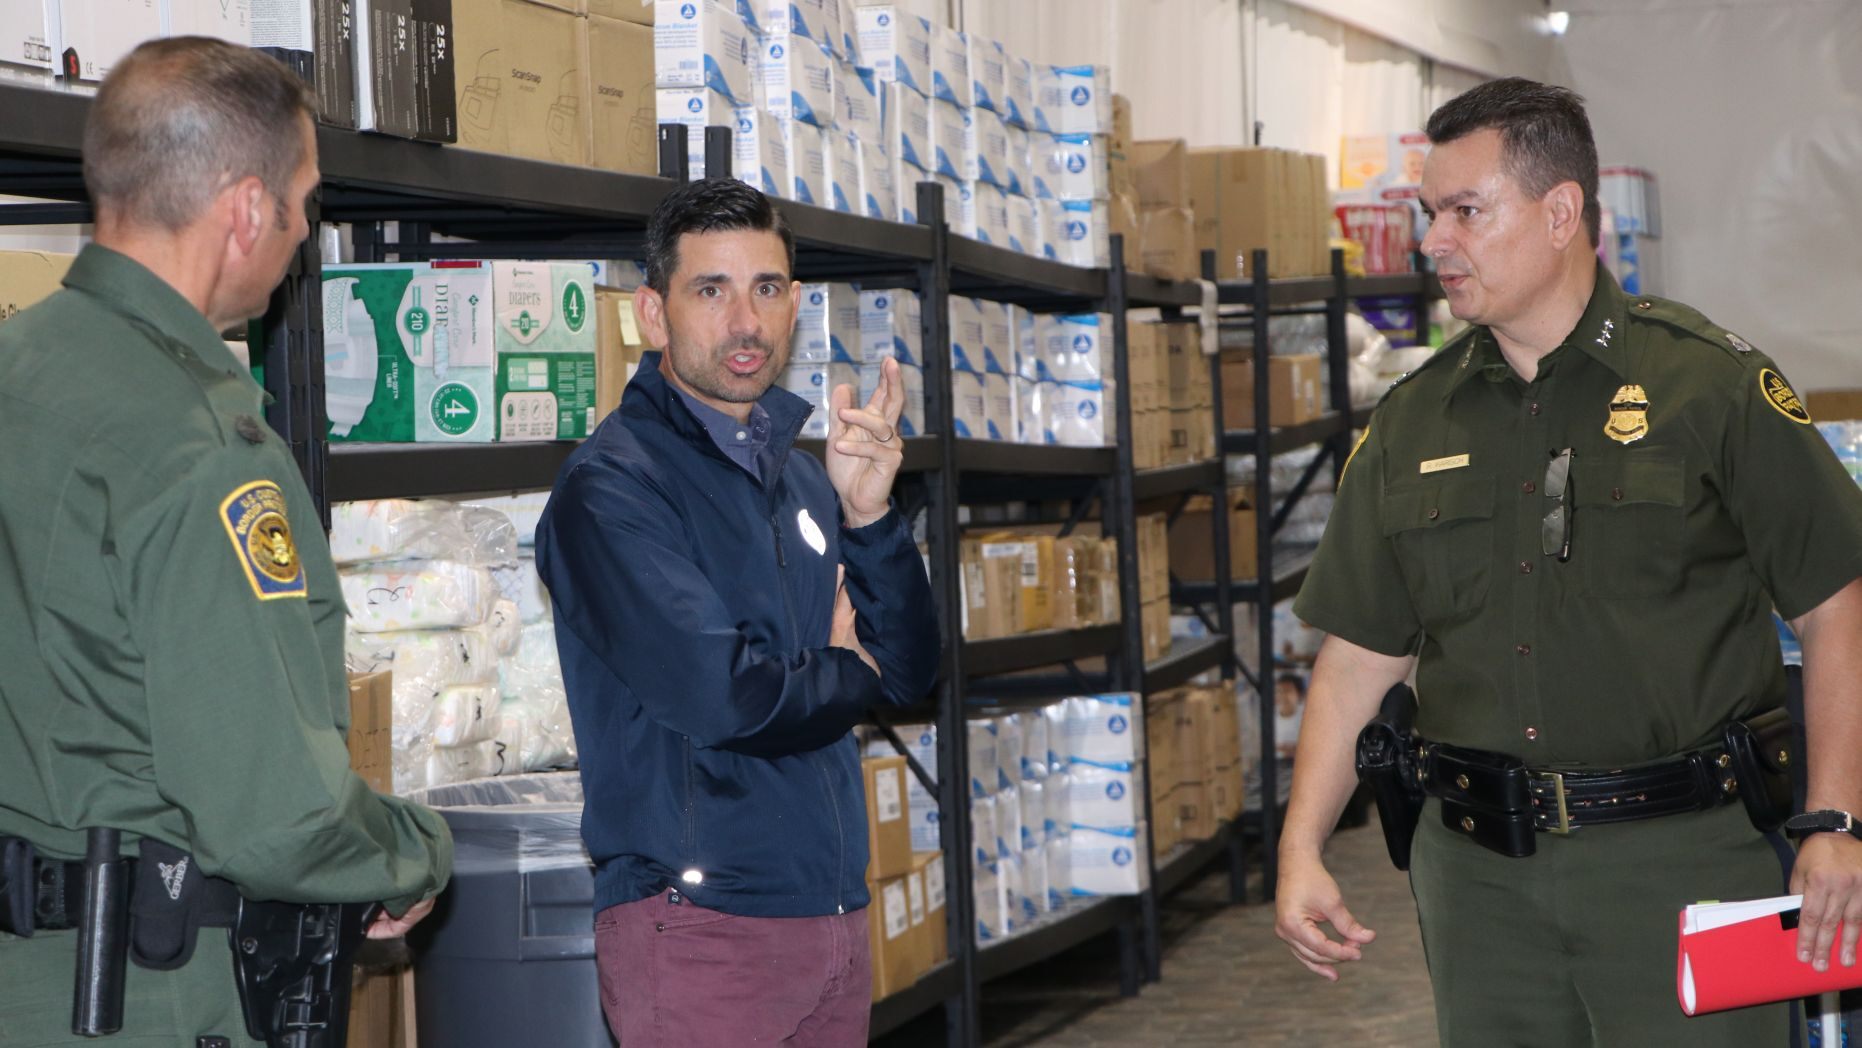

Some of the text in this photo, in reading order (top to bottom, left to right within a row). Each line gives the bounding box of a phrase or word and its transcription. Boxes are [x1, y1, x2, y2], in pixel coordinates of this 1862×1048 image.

[397, 15, 405, 51] 25x
[436, 24, 445, 60] 25x
[511, 68, 541, 84] ScanSnap
[598, 85, 624, 99] ScanSnap
[569, 290, 579, 318] 4
[411, 312, 424, 330] 210
[444, 399, 471, 418] 4
[236, 503, 263, 534] BORDER
[494, 740, 507, 776] 3
[170, 858, 187, 899] GERBER
